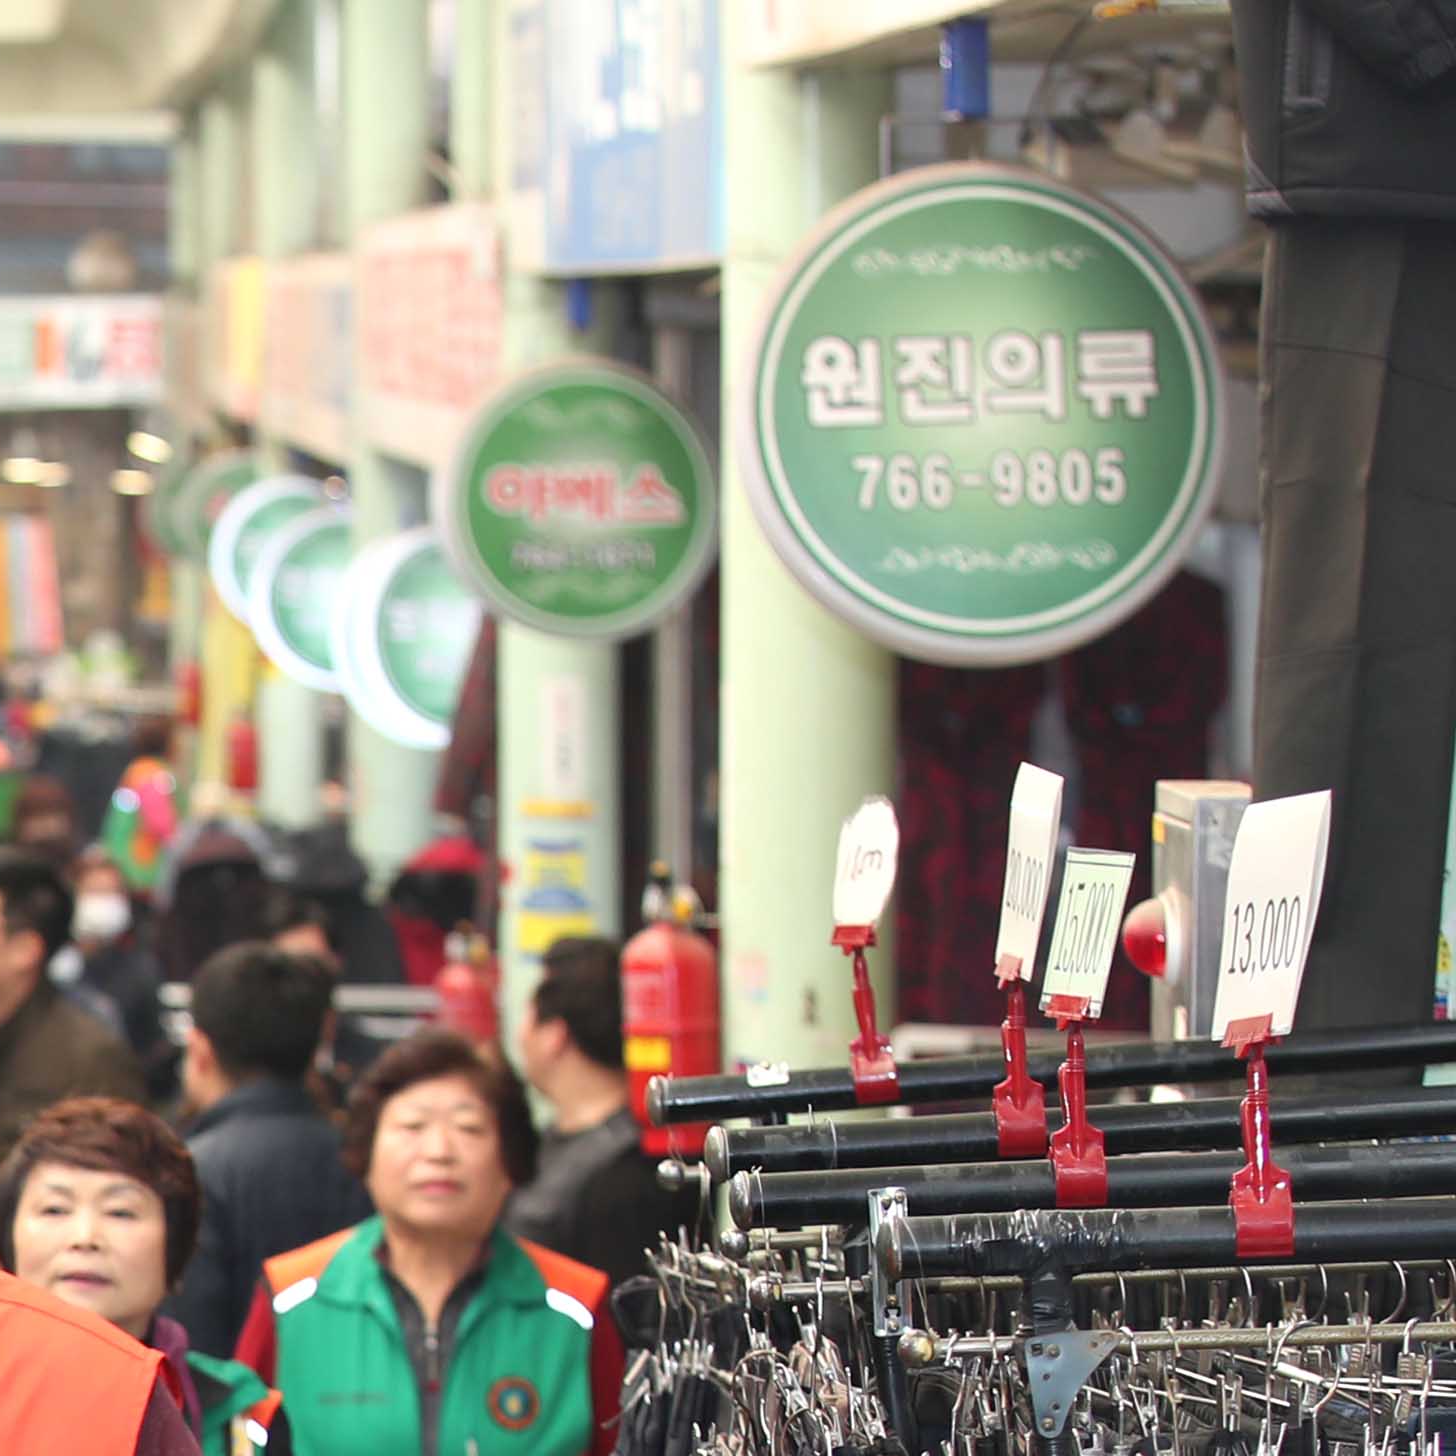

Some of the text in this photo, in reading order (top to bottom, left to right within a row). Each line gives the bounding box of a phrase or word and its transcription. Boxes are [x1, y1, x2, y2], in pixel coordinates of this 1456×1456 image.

[801, 329, 1159, 427] 원진의류
[852, 447, 1128, 511] 766-9805
[1227, 895, 1301, 982] 13,000
